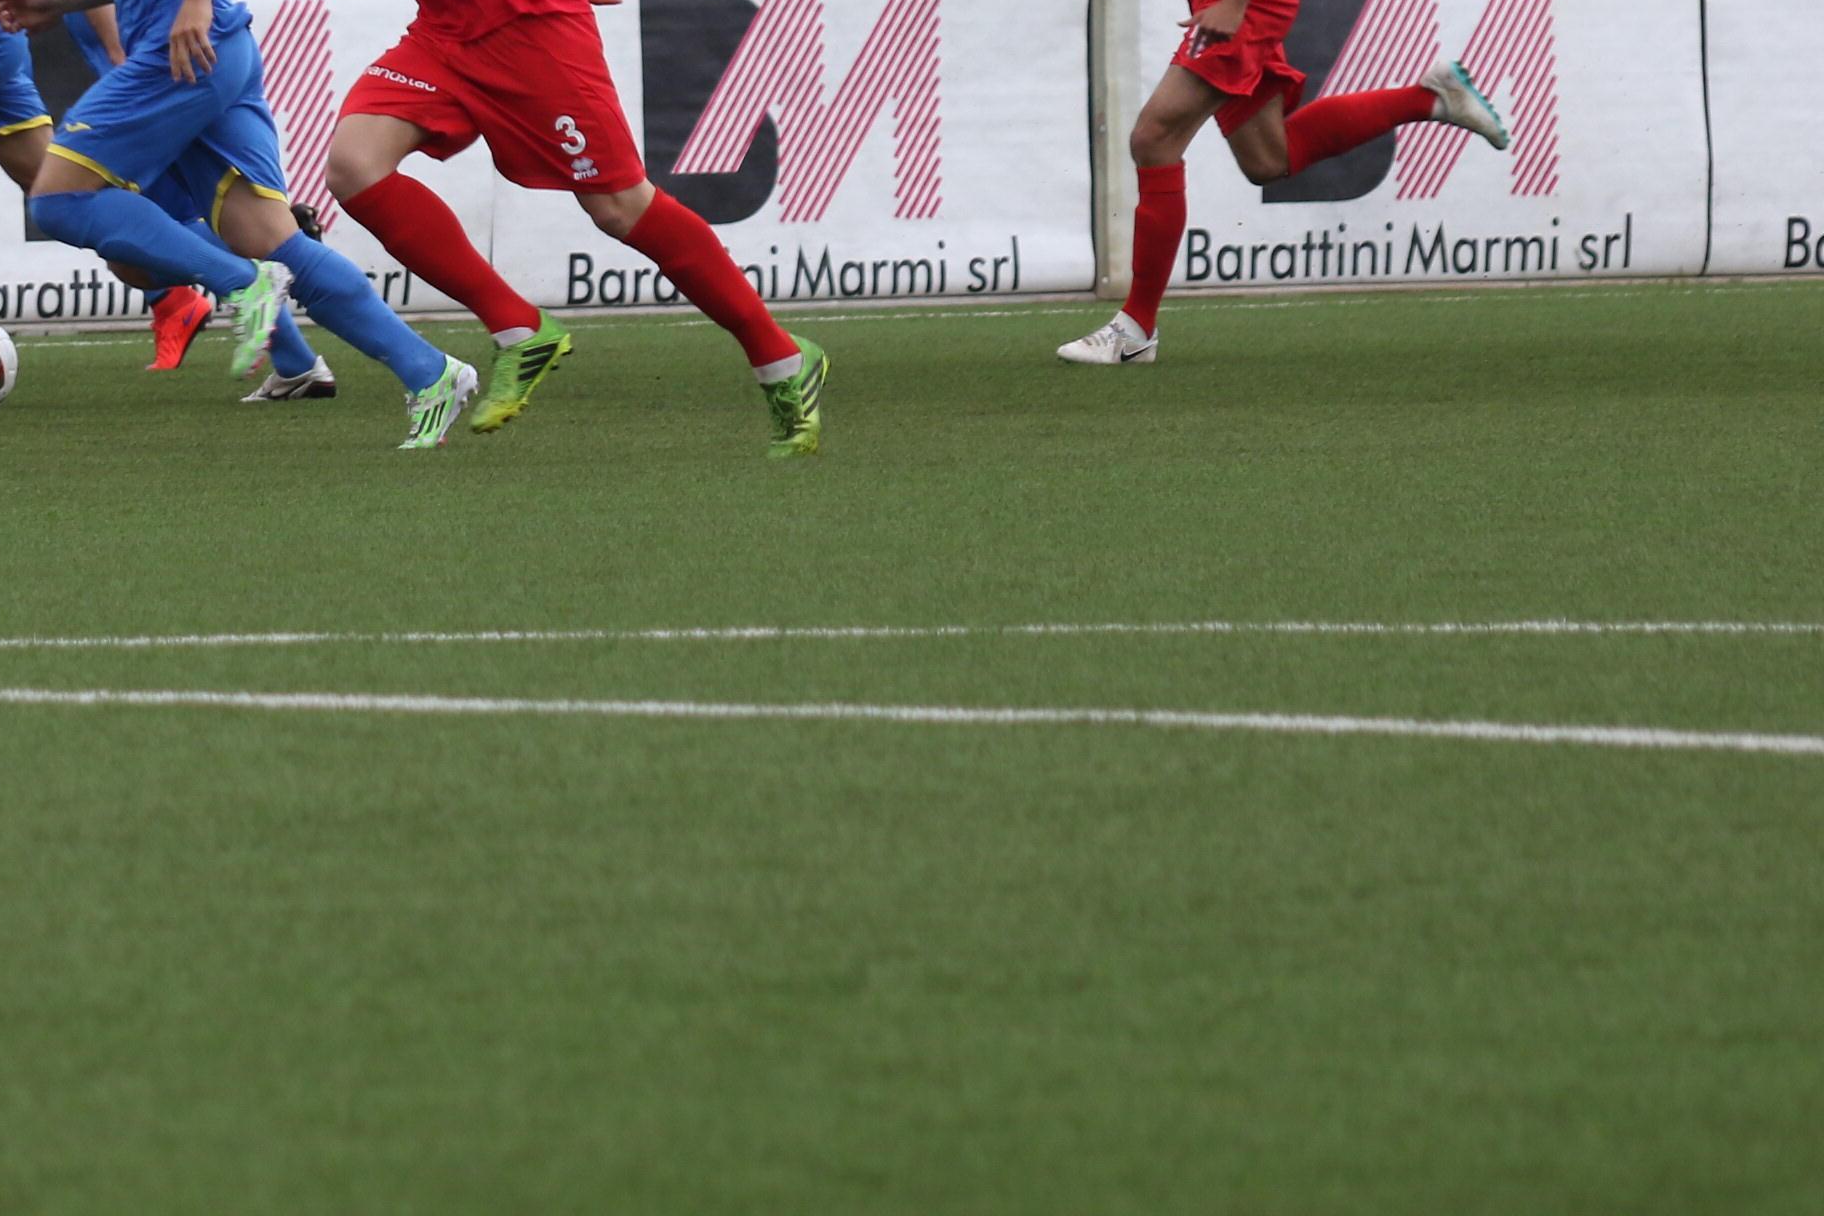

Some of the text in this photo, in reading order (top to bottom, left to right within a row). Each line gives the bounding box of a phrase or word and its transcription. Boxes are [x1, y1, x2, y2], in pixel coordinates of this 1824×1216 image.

[555, 115, 587, 155] 3
[790, 240, 948, 297] Marmi
[967, 235, 1019, 293] srl
[1185, 212, 1632, 281] Barattini Marmi srl
